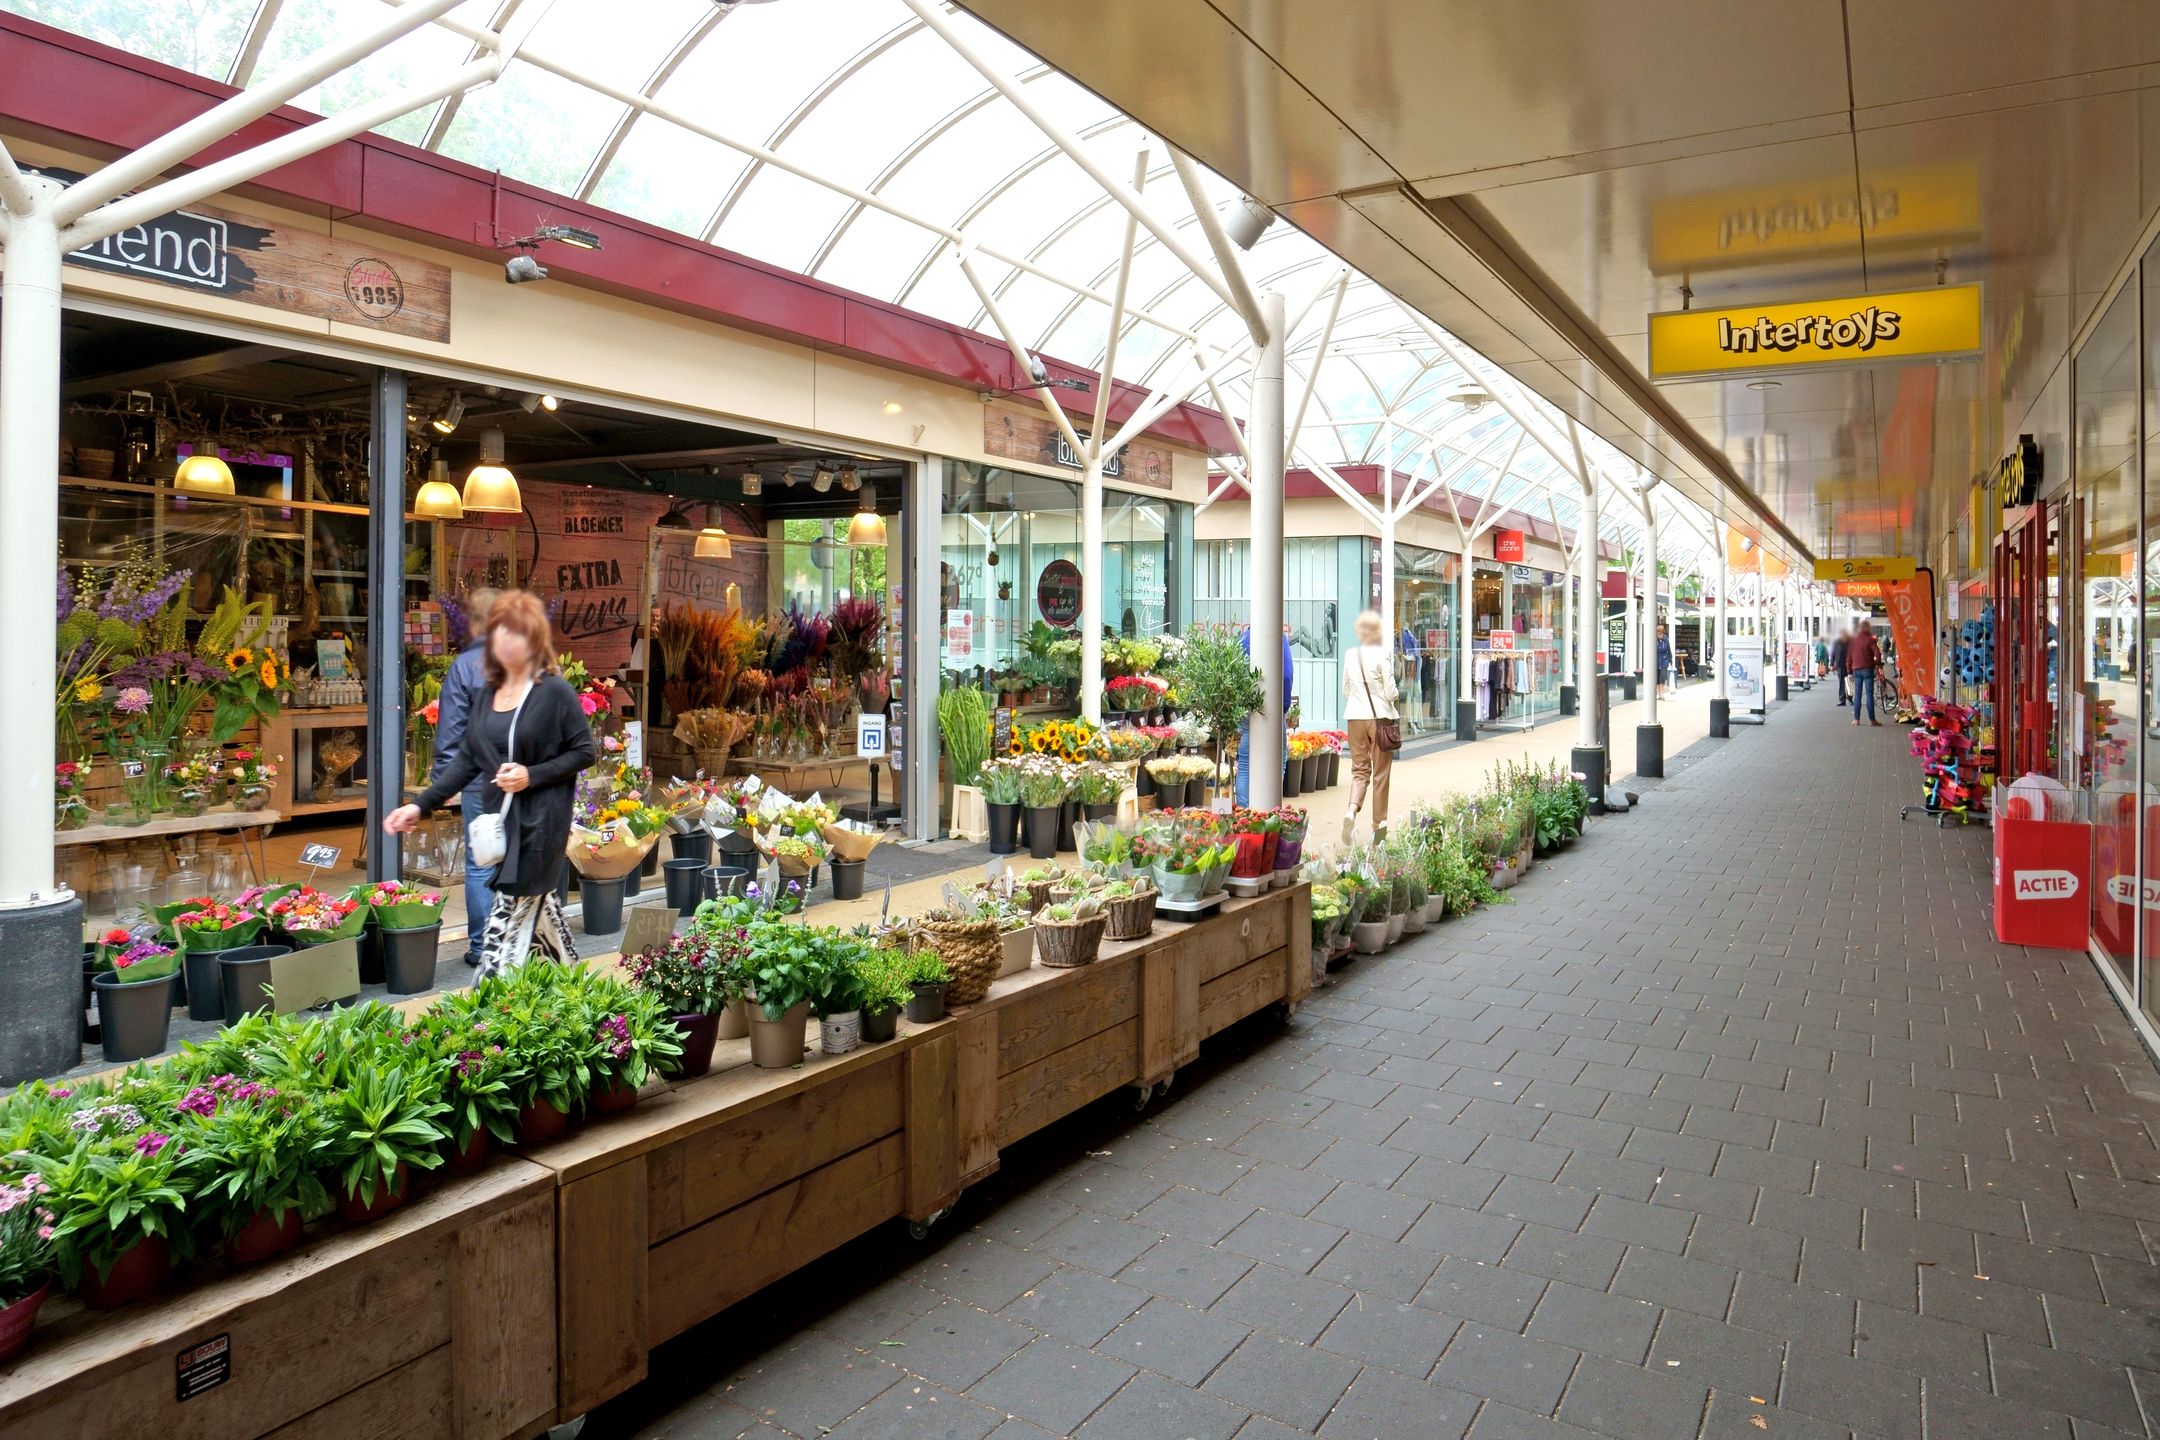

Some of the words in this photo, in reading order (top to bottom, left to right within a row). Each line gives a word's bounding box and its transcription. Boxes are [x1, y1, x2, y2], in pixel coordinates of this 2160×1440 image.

[1718, 306, 1901, 352] Intertoys
[565, 516, 624, 534] BLOEMEN
[557, 559, 623, 592] EXTRA
[560, 588, 628, 635] Vers
[2019, 877, 2068, 893] ACTIE
